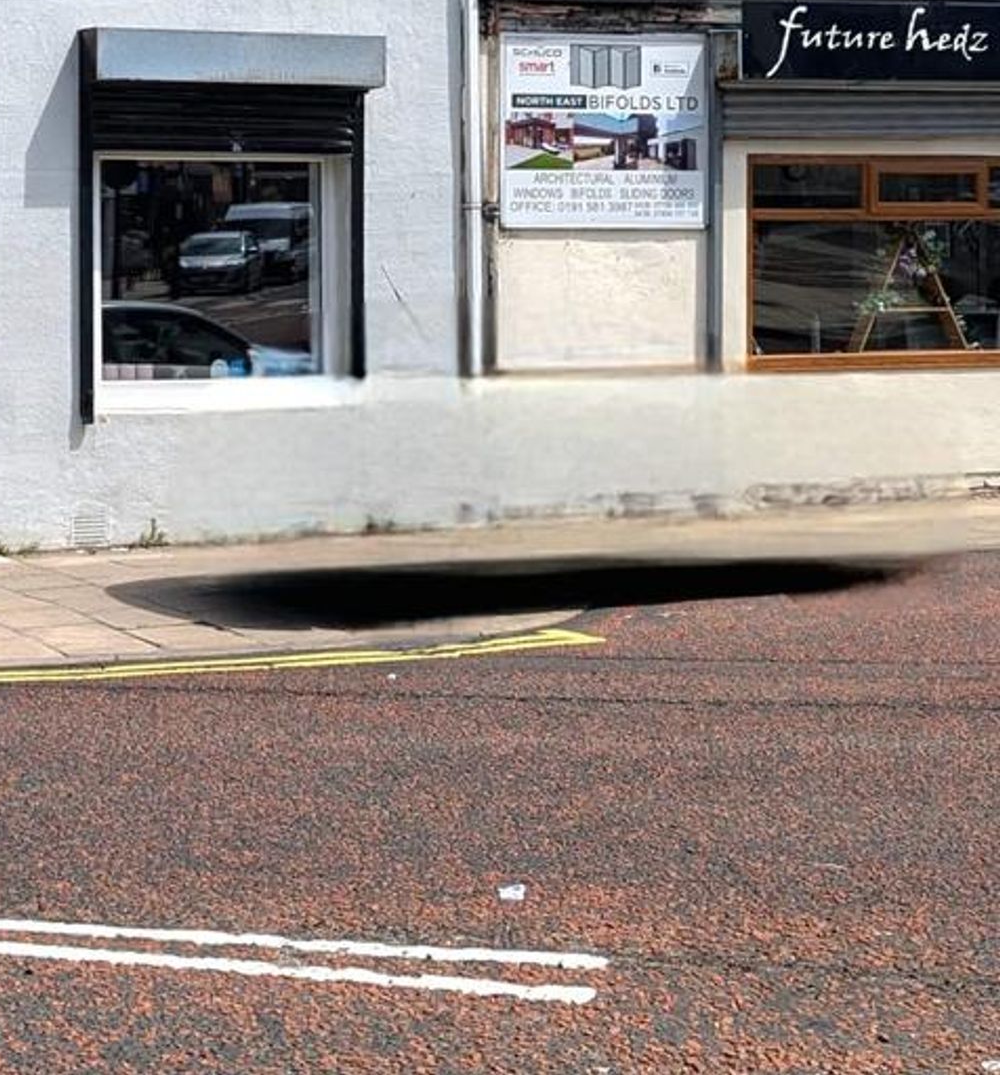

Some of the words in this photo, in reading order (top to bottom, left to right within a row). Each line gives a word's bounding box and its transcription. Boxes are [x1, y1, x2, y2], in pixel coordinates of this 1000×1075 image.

[766, 6, 895, 77] future
[905, 7, 988, 61] hedz
[518, 61, 555, 73] smart
[515, 96, 553, 106] NORTH
[556, 96, 584, 106] EAST
[588, 95, 662, 110] BIFOLDS
[666, 96, 699, 111] LTD
[532, 172, 615, 184] ARCHITECTURAL
[513, 187, 563, 199] WINDOWS
